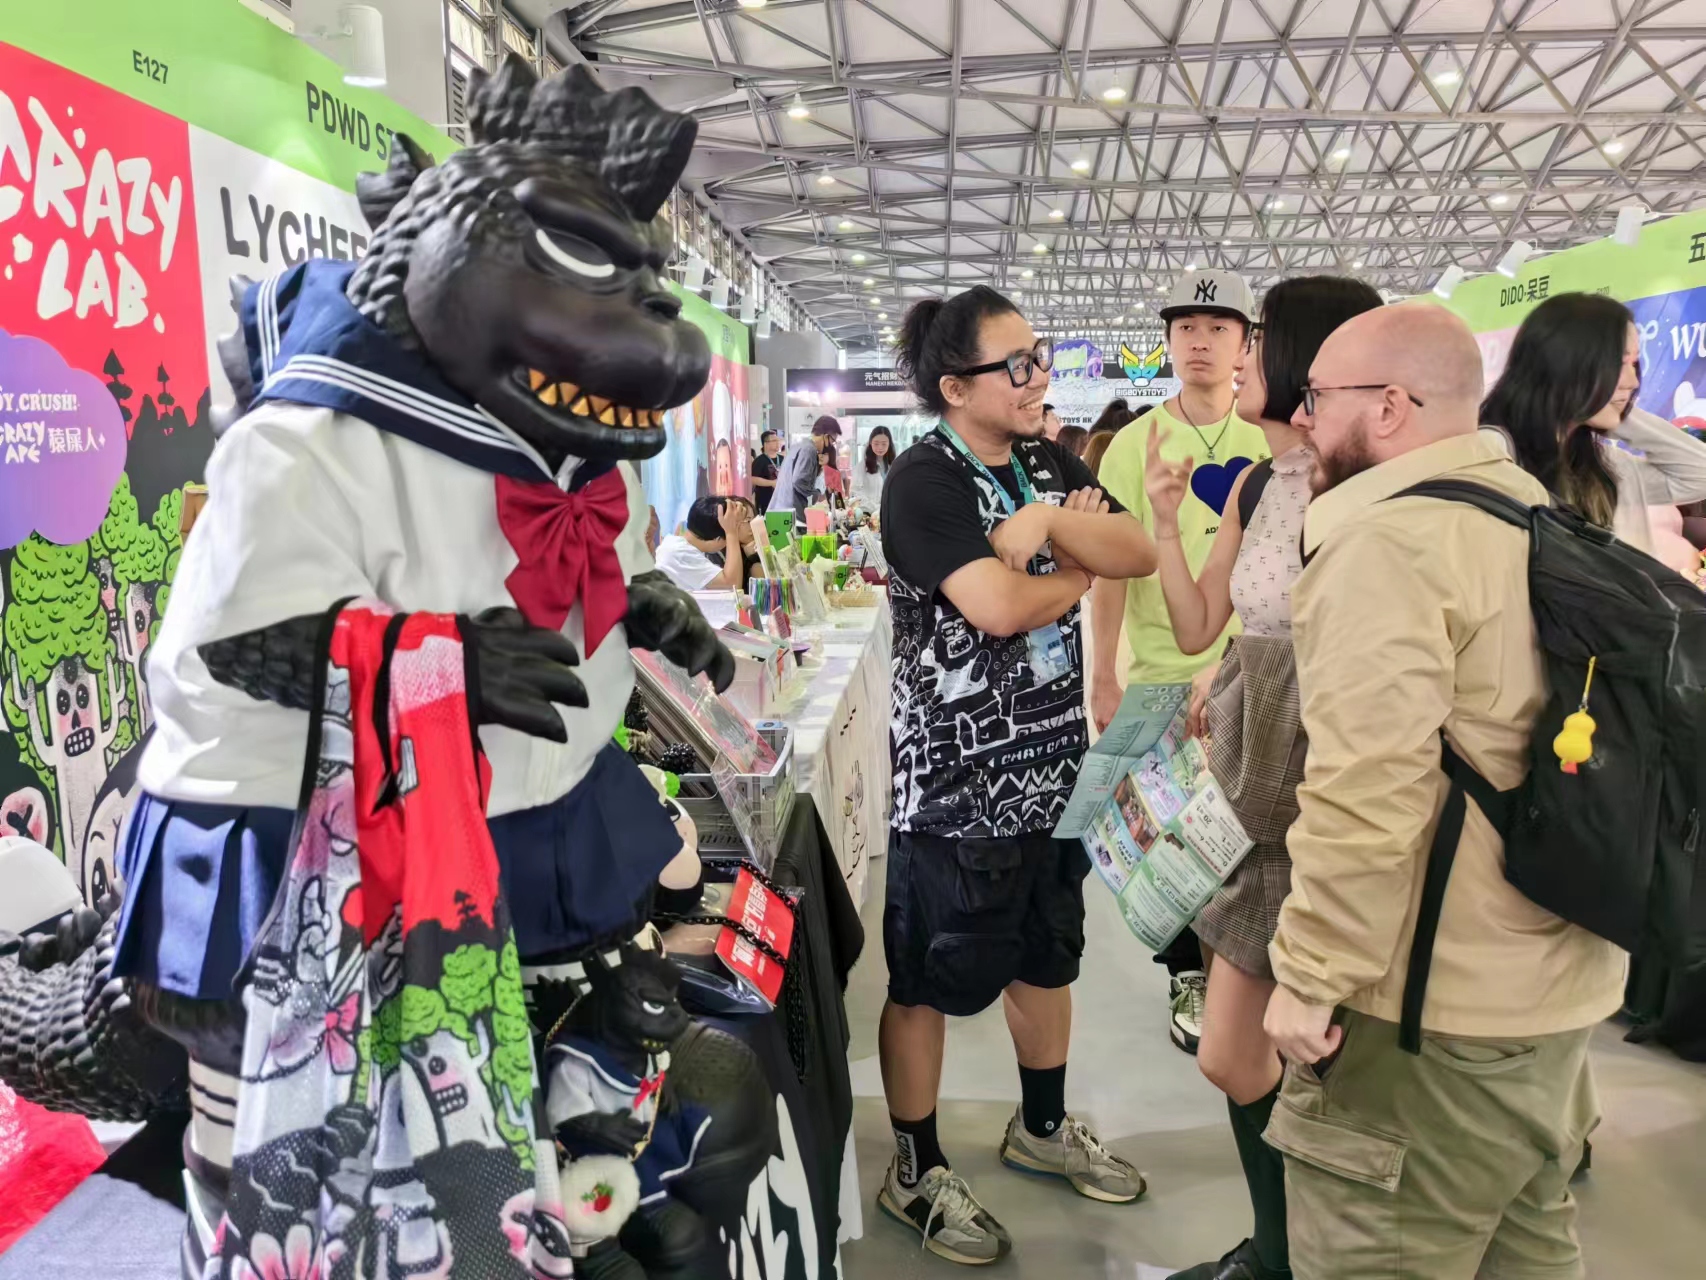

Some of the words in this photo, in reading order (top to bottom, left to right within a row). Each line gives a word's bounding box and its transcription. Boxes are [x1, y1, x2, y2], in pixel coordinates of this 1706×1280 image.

[133, 49, 168, 84] E127
[305, 80, 370, 152] PDWD
[37, 239, 149, 329] LAB
[1193, 278, 1218, 303] NY
[1115, 388, 1167, 397] BIGBOYSTOYS
[5, 443, 41, 464] APE
[964, 452, 982, 468] BACK
